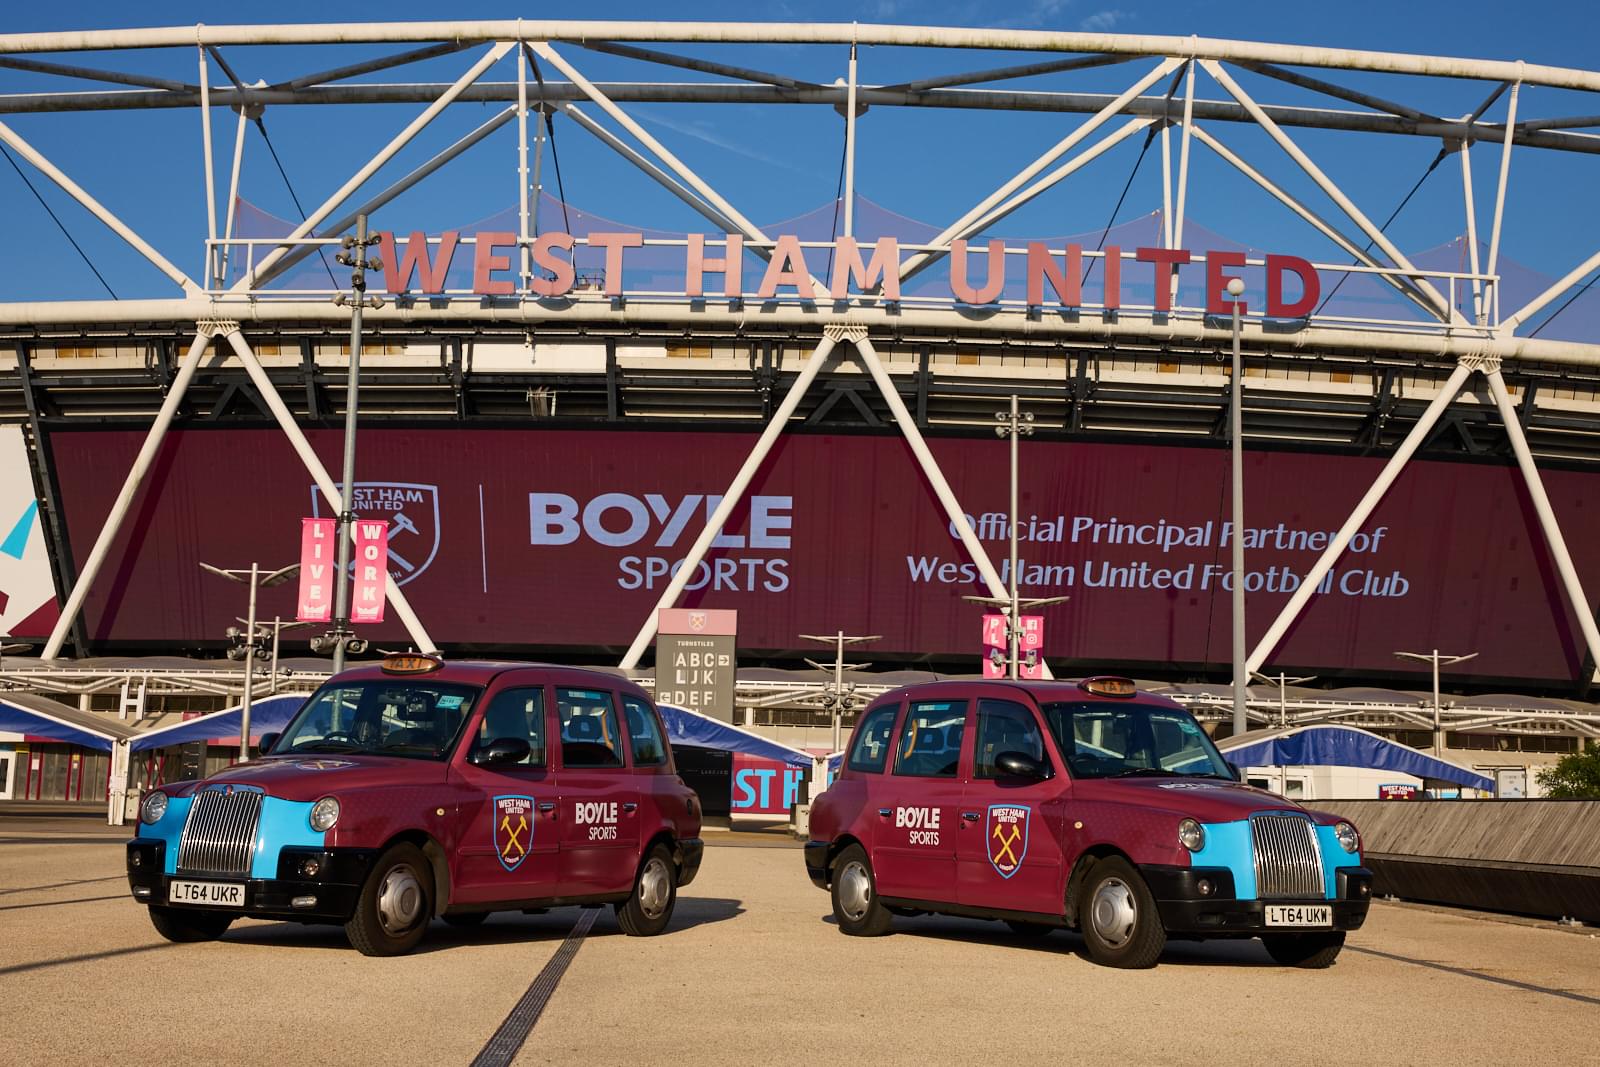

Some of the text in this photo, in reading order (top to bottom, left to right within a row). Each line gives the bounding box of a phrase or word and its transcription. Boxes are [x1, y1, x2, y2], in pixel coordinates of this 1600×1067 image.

[379, 231, 1320, 318] WEST HAM UNITED
[380, 489, 424, 503] HAM
[529, 492, 793, 549] BOYLE
[1071, 516, 1213, 553] Principal
[1349, 526, 1388, 553] of
[309, 522, 325, 600] LIVE
[362, 524, 382, 601] WORK
[617, 556, 790, 592] SPORTS
[906, 556, 1409, 597] Wes Ham United Footbll Club
[732, 768, 777, 808] ST
[498, 799, 531, 809] WEST HAM
[576, 803, 618, 824] BOYLE
[993, 808, 1025, 819] WEST HAM
[896, 806, 940, 829] BOYLE
[588, 827, 617, 840] SPORTS
[909, 831, 940, 845] SPORTS
[175, 884, 239, 902] LT64 UKR
[1271, 908, 1327, 923] LT64 UKW
